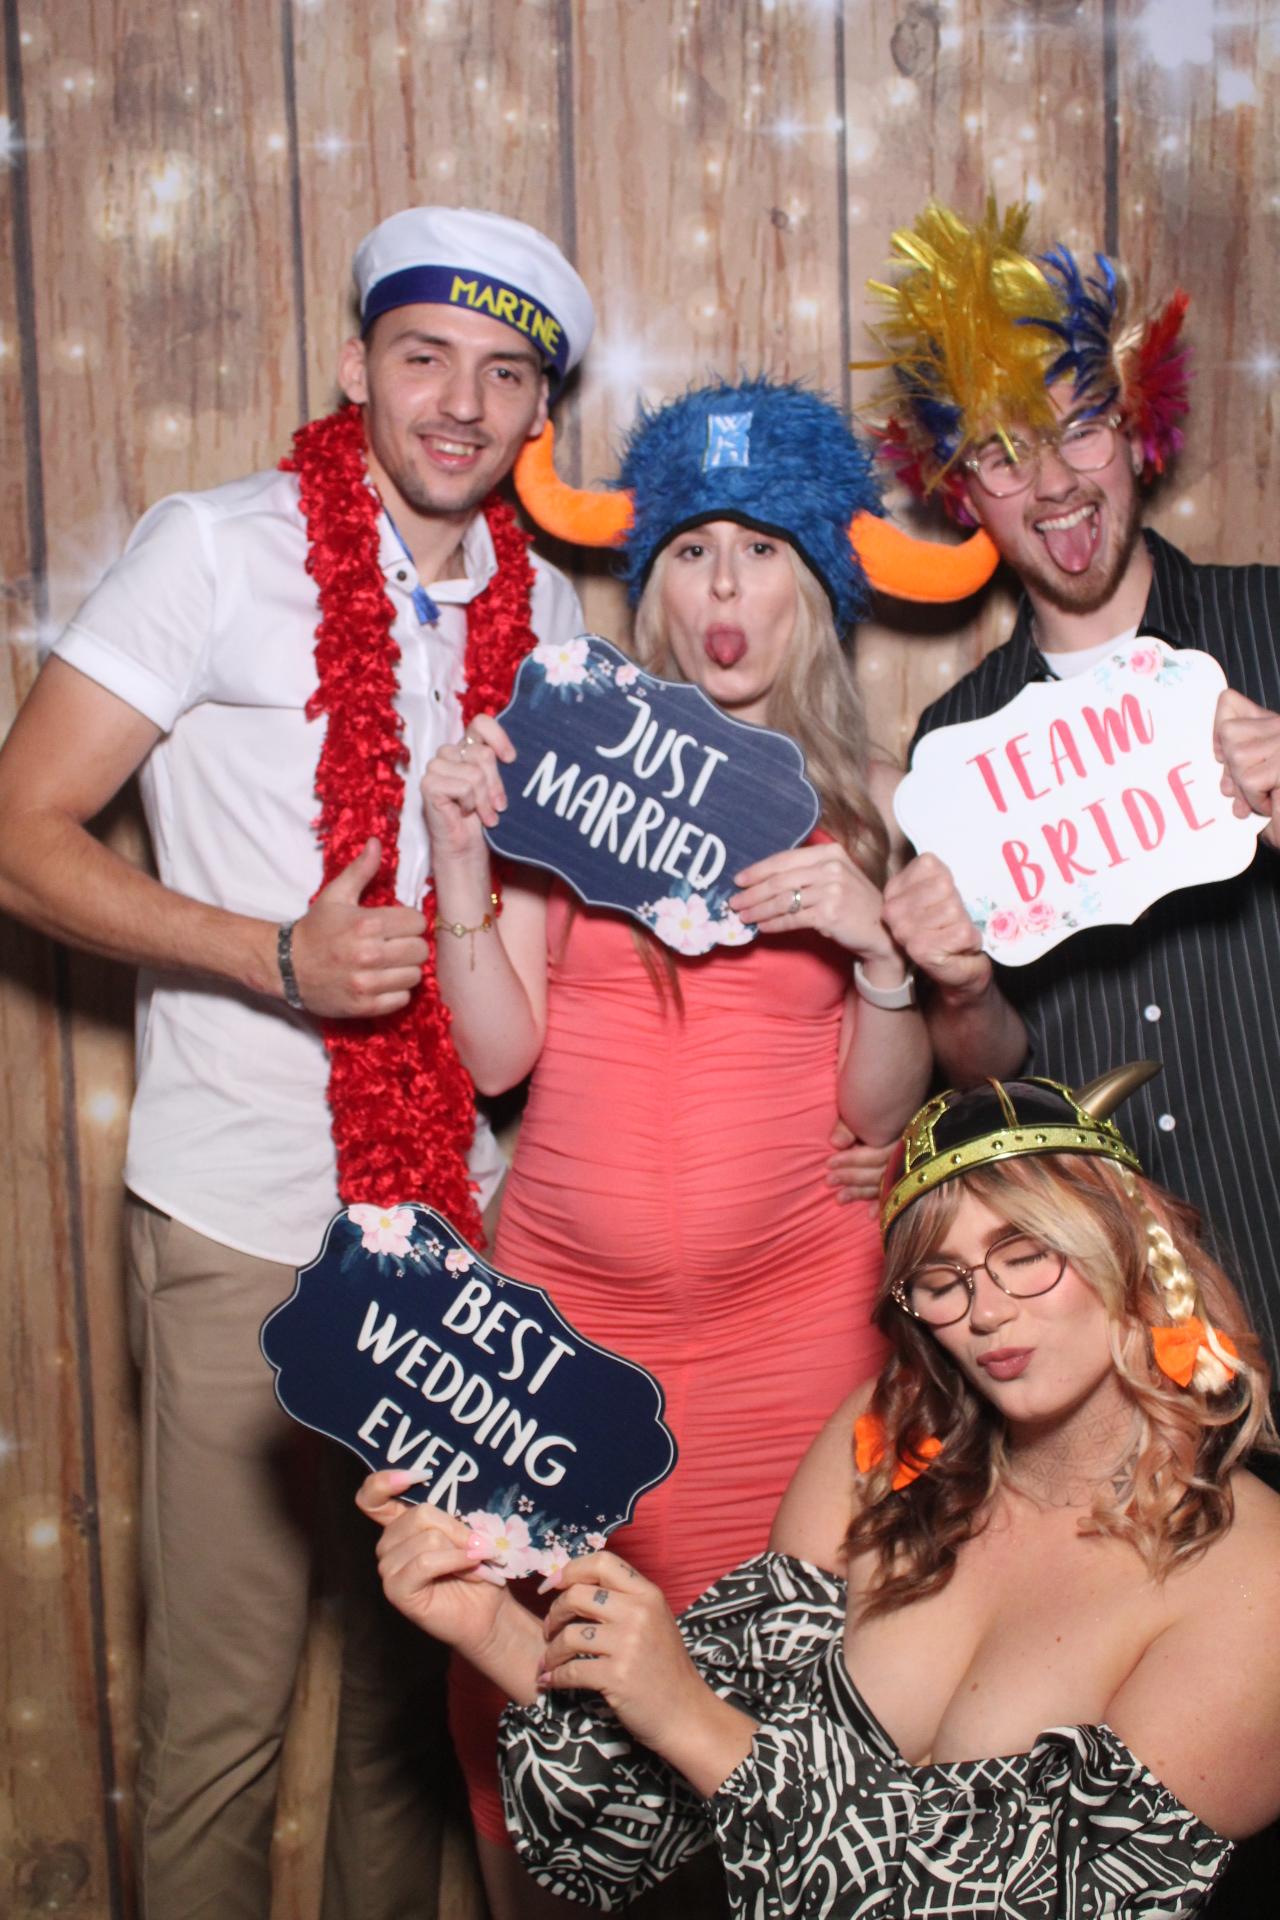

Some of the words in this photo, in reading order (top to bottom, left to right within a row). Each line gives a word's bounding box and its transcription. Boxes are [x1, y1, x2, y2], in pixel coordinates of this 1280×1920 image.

[449, 275, 562, 356] MARINE
[595, 694, 728, 807] JUST
[966, 693, 1154, 813] TEAM
[522, 751, 726, 890] MARRIED
[1001, 761, 1215, 903] BRIDE
[356, 1301, 577, 1487] WEDDING
[441, 1277, 576, 1395] BEST
[357, 1398, 479, 1517] EVER
